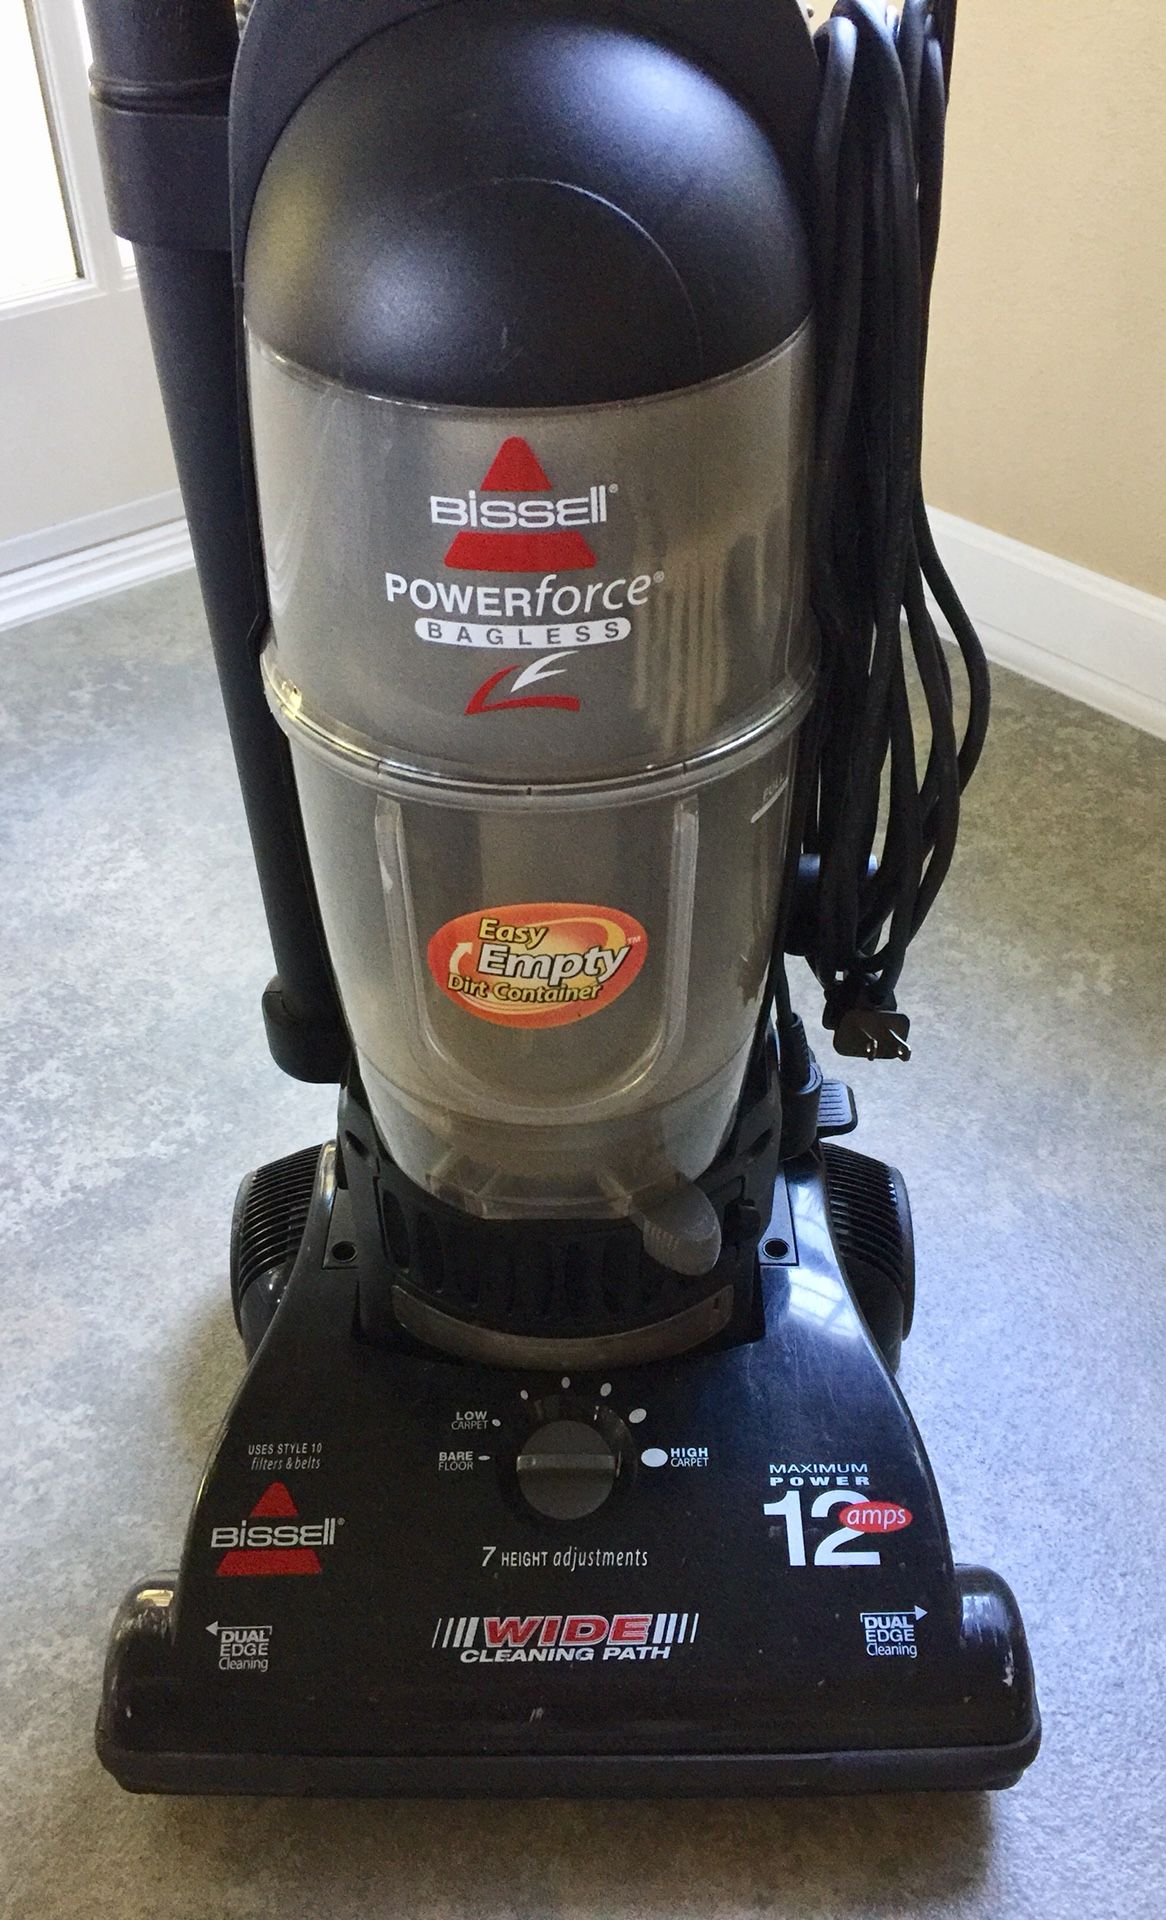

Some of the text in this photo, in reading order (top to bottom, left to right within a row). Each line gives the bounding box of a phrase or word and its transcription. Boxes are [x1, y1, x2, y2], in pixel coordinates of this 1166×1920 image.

[427, 621, 620, 645] BAGLESS
[478, 917, 548, 950] Easy
[477, 943, 631, 987] Empty
[448, 972, 603, 1003] Dirt Container
[455, 1411, 488, 1421] LOW
[451, 1420, 488, 1430] CARPET
[248, 1443, 322, 1455] USES STYLE 10
[438, 1451, 474, 1461] BARE
[670, 1447, 709, 1458] HIGH
[251, 1457, 283, 1470] filters
[294, 1456, 321, 1469] belts
[438, 1460, 474, 1471] FLOOR
[670, 1457, 709, 1468] CARPET
[769, 1463, 868, 1474] MAXIMUM
[769, 1476, 870, 1487] POWER
[846, 1507, 907, 1530] amps
[763, 1489, 881, 1567] 12
[481, 1546, 649, 1572] 7 HEIGHT adjustments
[864, 1616, 914, 1629] DUAL
[220, 1630, 270, 1644] DUAL
[483, 1613, 654, 1648] WIDE
[865, 1629, 916, 1642] EDGE
[219, 1643, 269, 1657] EDGE
[460, 1646, 671, 1664] CLEANING PATH
[866, 1642, 918, 1659] Cleaning
[218, 1656, 269, 1673] Cleaning
